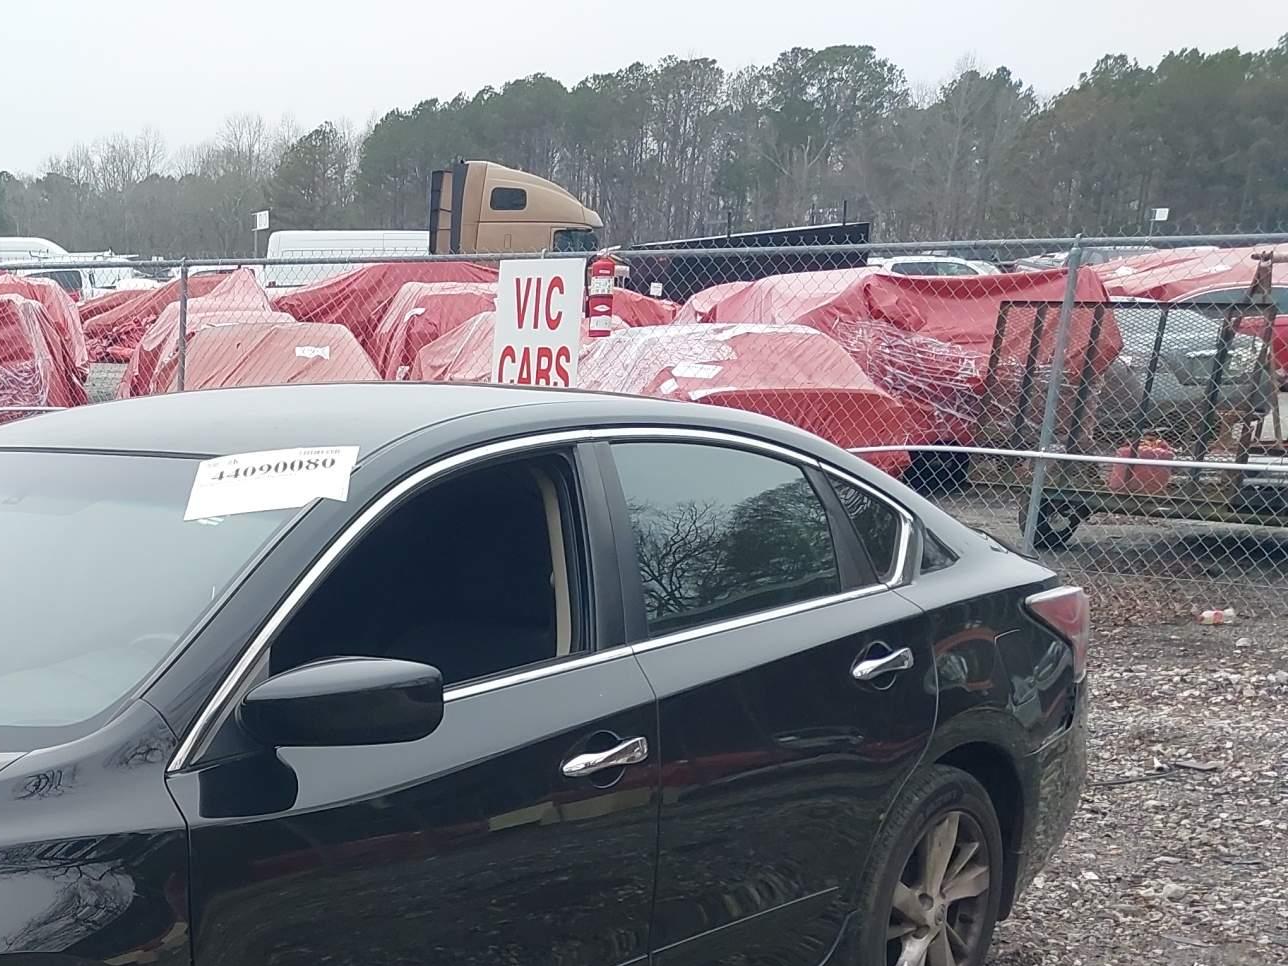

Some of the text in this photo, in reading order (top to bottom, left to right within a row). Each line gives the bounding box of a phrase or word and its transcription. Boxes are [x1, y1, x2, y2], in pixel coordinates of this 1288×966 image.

[515, 276, 565, 330] VIC
[498, 345, 571, 388] CARS
[210, 457, 336, 481] 44090080
